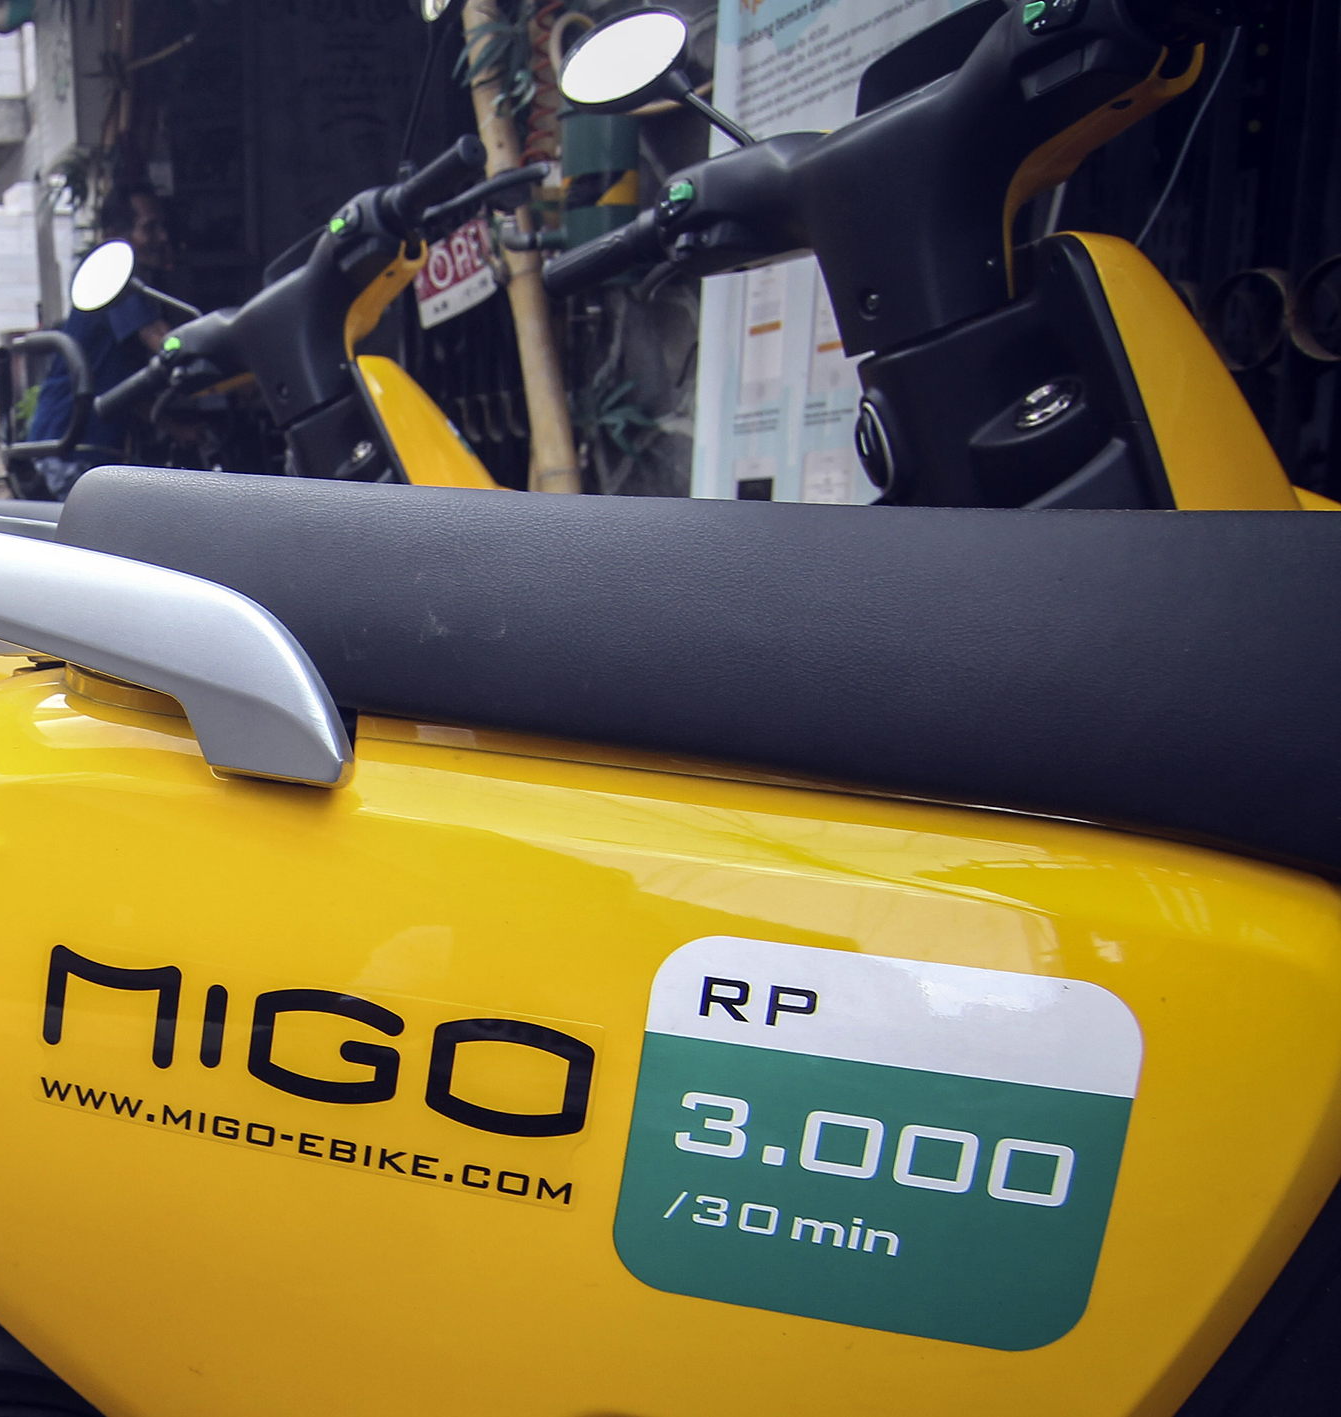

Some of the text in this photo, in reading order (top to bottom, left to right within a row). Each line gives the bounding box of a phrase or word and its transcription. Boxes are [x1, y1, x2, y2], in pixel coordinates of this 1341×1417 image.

[43, 944, 596, 1137] MIGO
[698, 975, 819, 1027] RP
[40, 1076, 573, 1205] WWW.MIGO-EBIKE.COM
[674, 1091, 1076, 1208] 3.000
[790, 1216, 900, 1257] min
